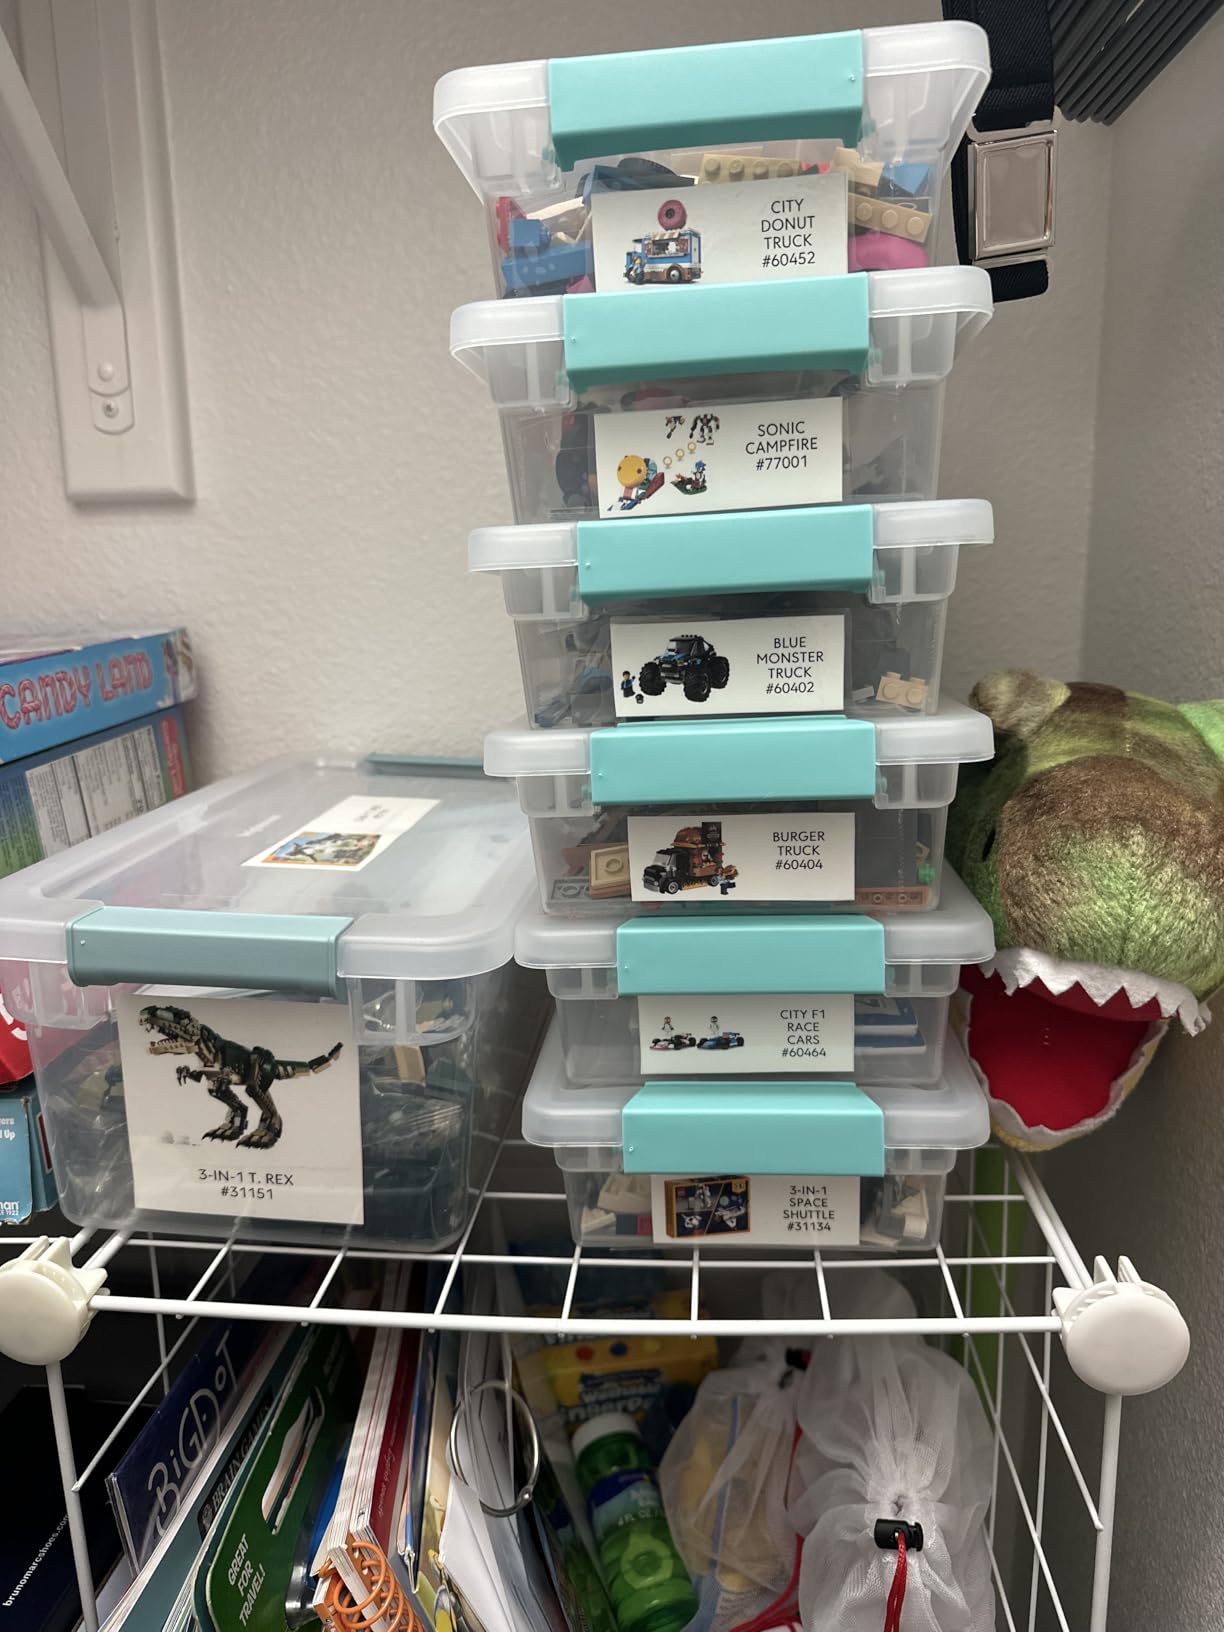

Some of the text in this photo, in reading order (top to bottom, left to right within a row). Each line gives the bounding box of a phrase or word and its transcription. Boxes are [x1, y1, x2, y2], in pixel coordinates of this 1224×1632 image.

[770, 198, 804, 214] CITY
[761, 215, 815, 232] DONUT
[763, 233, 812, 249] TRUCK
[762, 251, 815, 267] #60452
[757, 421, 805, 437] SONIC
[745, 437, 818, 454] CAMPFIRE
[756, 455, 807, 470] #77001
[773, 636, 806, 649] BLUE
[756, 651, 824, 664] MONSTER
[768, 666, 812, 679] TRUCK
[0, 651, 153, 730] CANDY LAND
[766, 681, 814, 694] #60402
[772, 831, 825, 842] BURGER
[777, 845, 820, 856] TRUCK
[775, 859, 823, 870] #60404
[780, 1009, 825, 1020] CITY F1
[787, 1022, 820, 1032] RACE
[787, 1035, 820, 1045] CARS
[782, 1047, 826, 1058] #60464
[198, 1168, 294, 1186] 3-IN-1 T. REX
[221, 1186, 273, 1199] #31151
[790, 1185, 827, 1195] 3-IN-1
[789, 1198, 828, 1207] SPACE
[783, 1209, 835, 1219] SHUTTLE
[787, 1221, 831, 1231] #31134
[228, 1533, 249, 1586] GREAT
[237, 1560, 254, 1597] FOR
[239, 1563, 266, 1627] TRAVEL!
